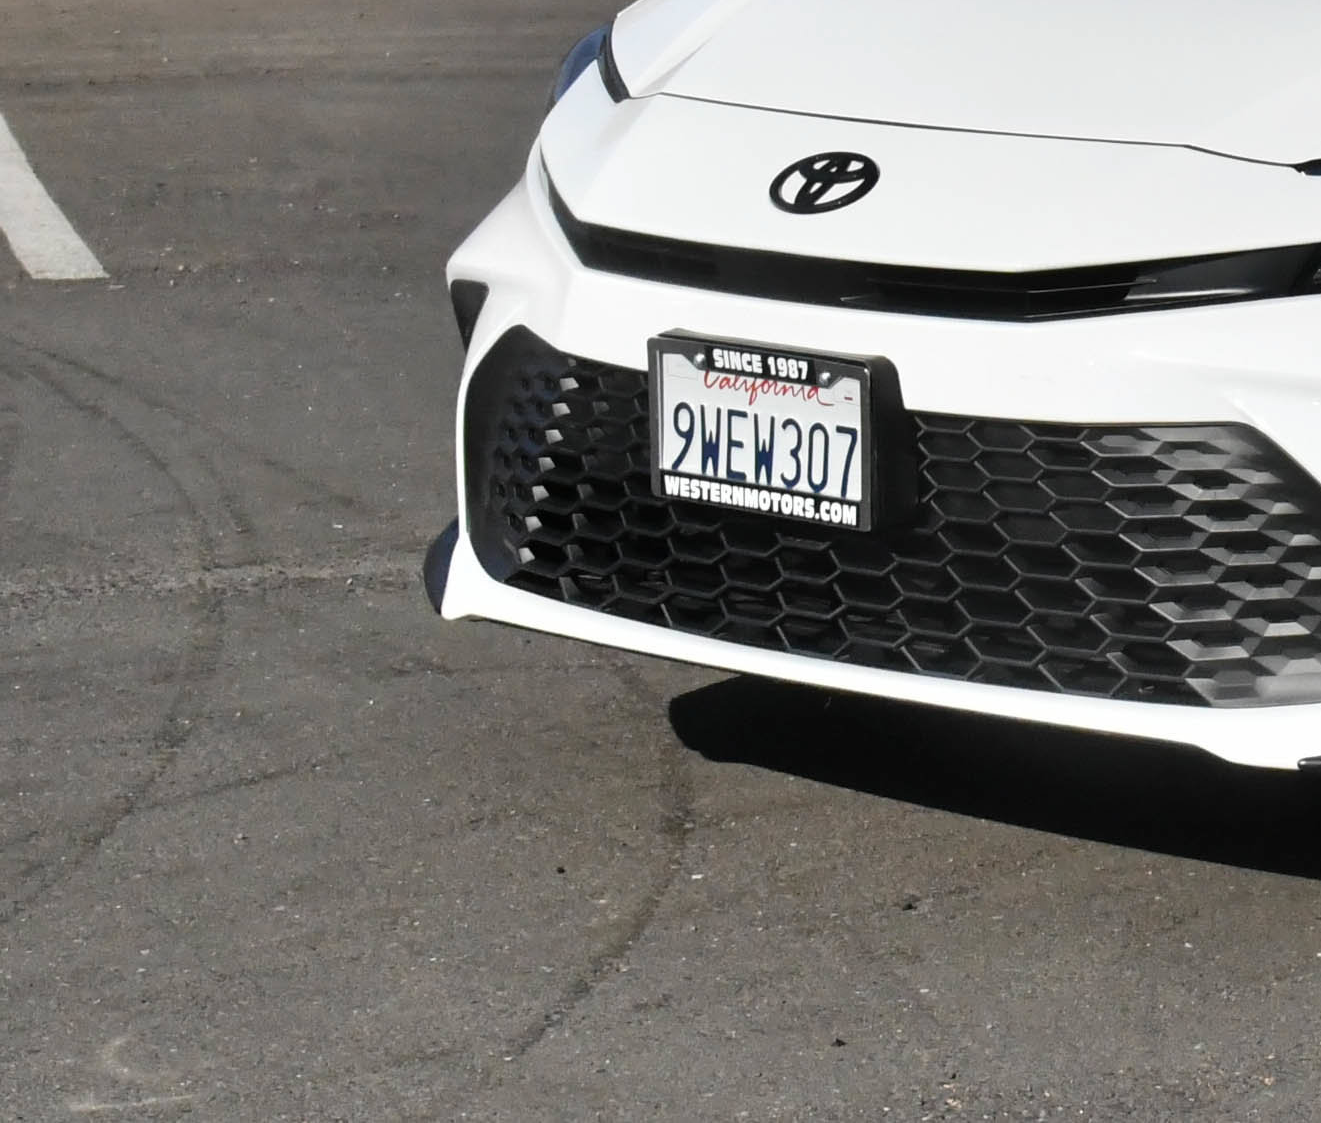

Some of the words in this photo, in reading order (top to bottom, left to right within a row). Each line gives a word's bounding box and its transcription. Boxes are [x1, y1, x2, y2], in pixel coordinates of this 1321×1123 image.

[711, 348, 763, 374] SINCE
[767, 356, 809, 380] 1987
[703, 370, 834, 406] California
[671, 401, 858, 499] 9WEW307
[664, 475, 857, 526] WESTERNMOTORS.COM
